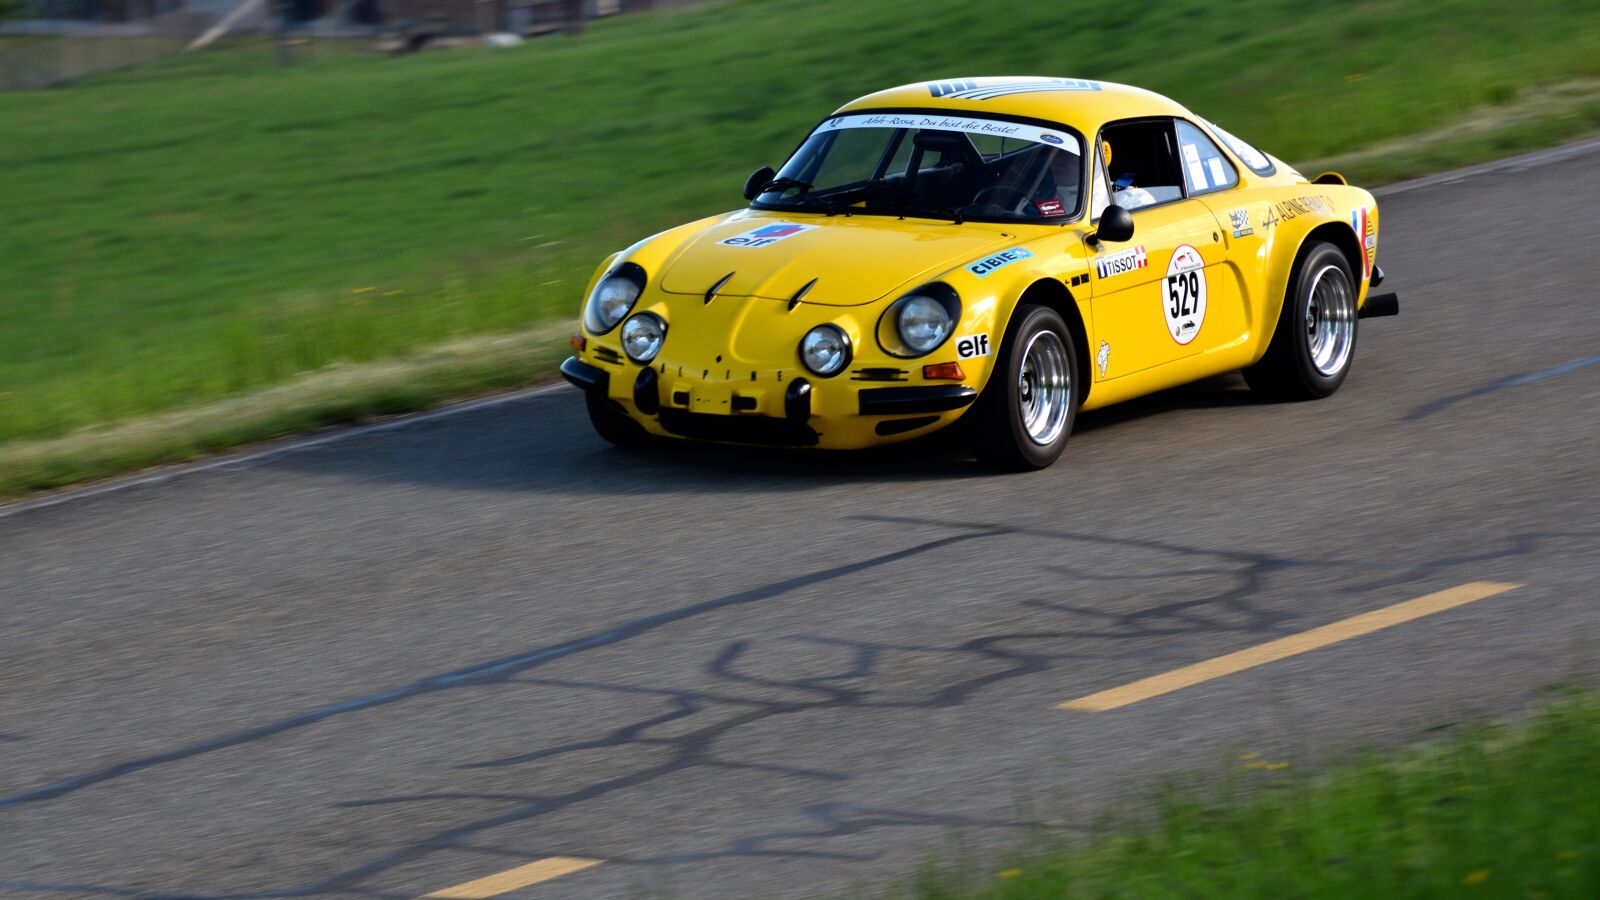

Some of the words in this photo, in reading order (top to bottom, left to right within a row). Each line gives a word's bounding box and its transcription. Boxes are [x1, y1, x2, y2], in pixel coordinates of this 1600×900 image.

[919, 118, 937, 126] Du
[938, 118, 961, 129] bist
[962, 120, 980, 130] die
[981, 123, 1020, 134] Beste!
[724, 237, 776, 247] elf
[971, 252, 1018, 275] CIBIE
[1106, 254, 1137, 275] TISSOT
[1168, 271, 1199, 319] 529
[957, 334, 988, 358] elf
[660, 363, 783, 382] ALPINE
